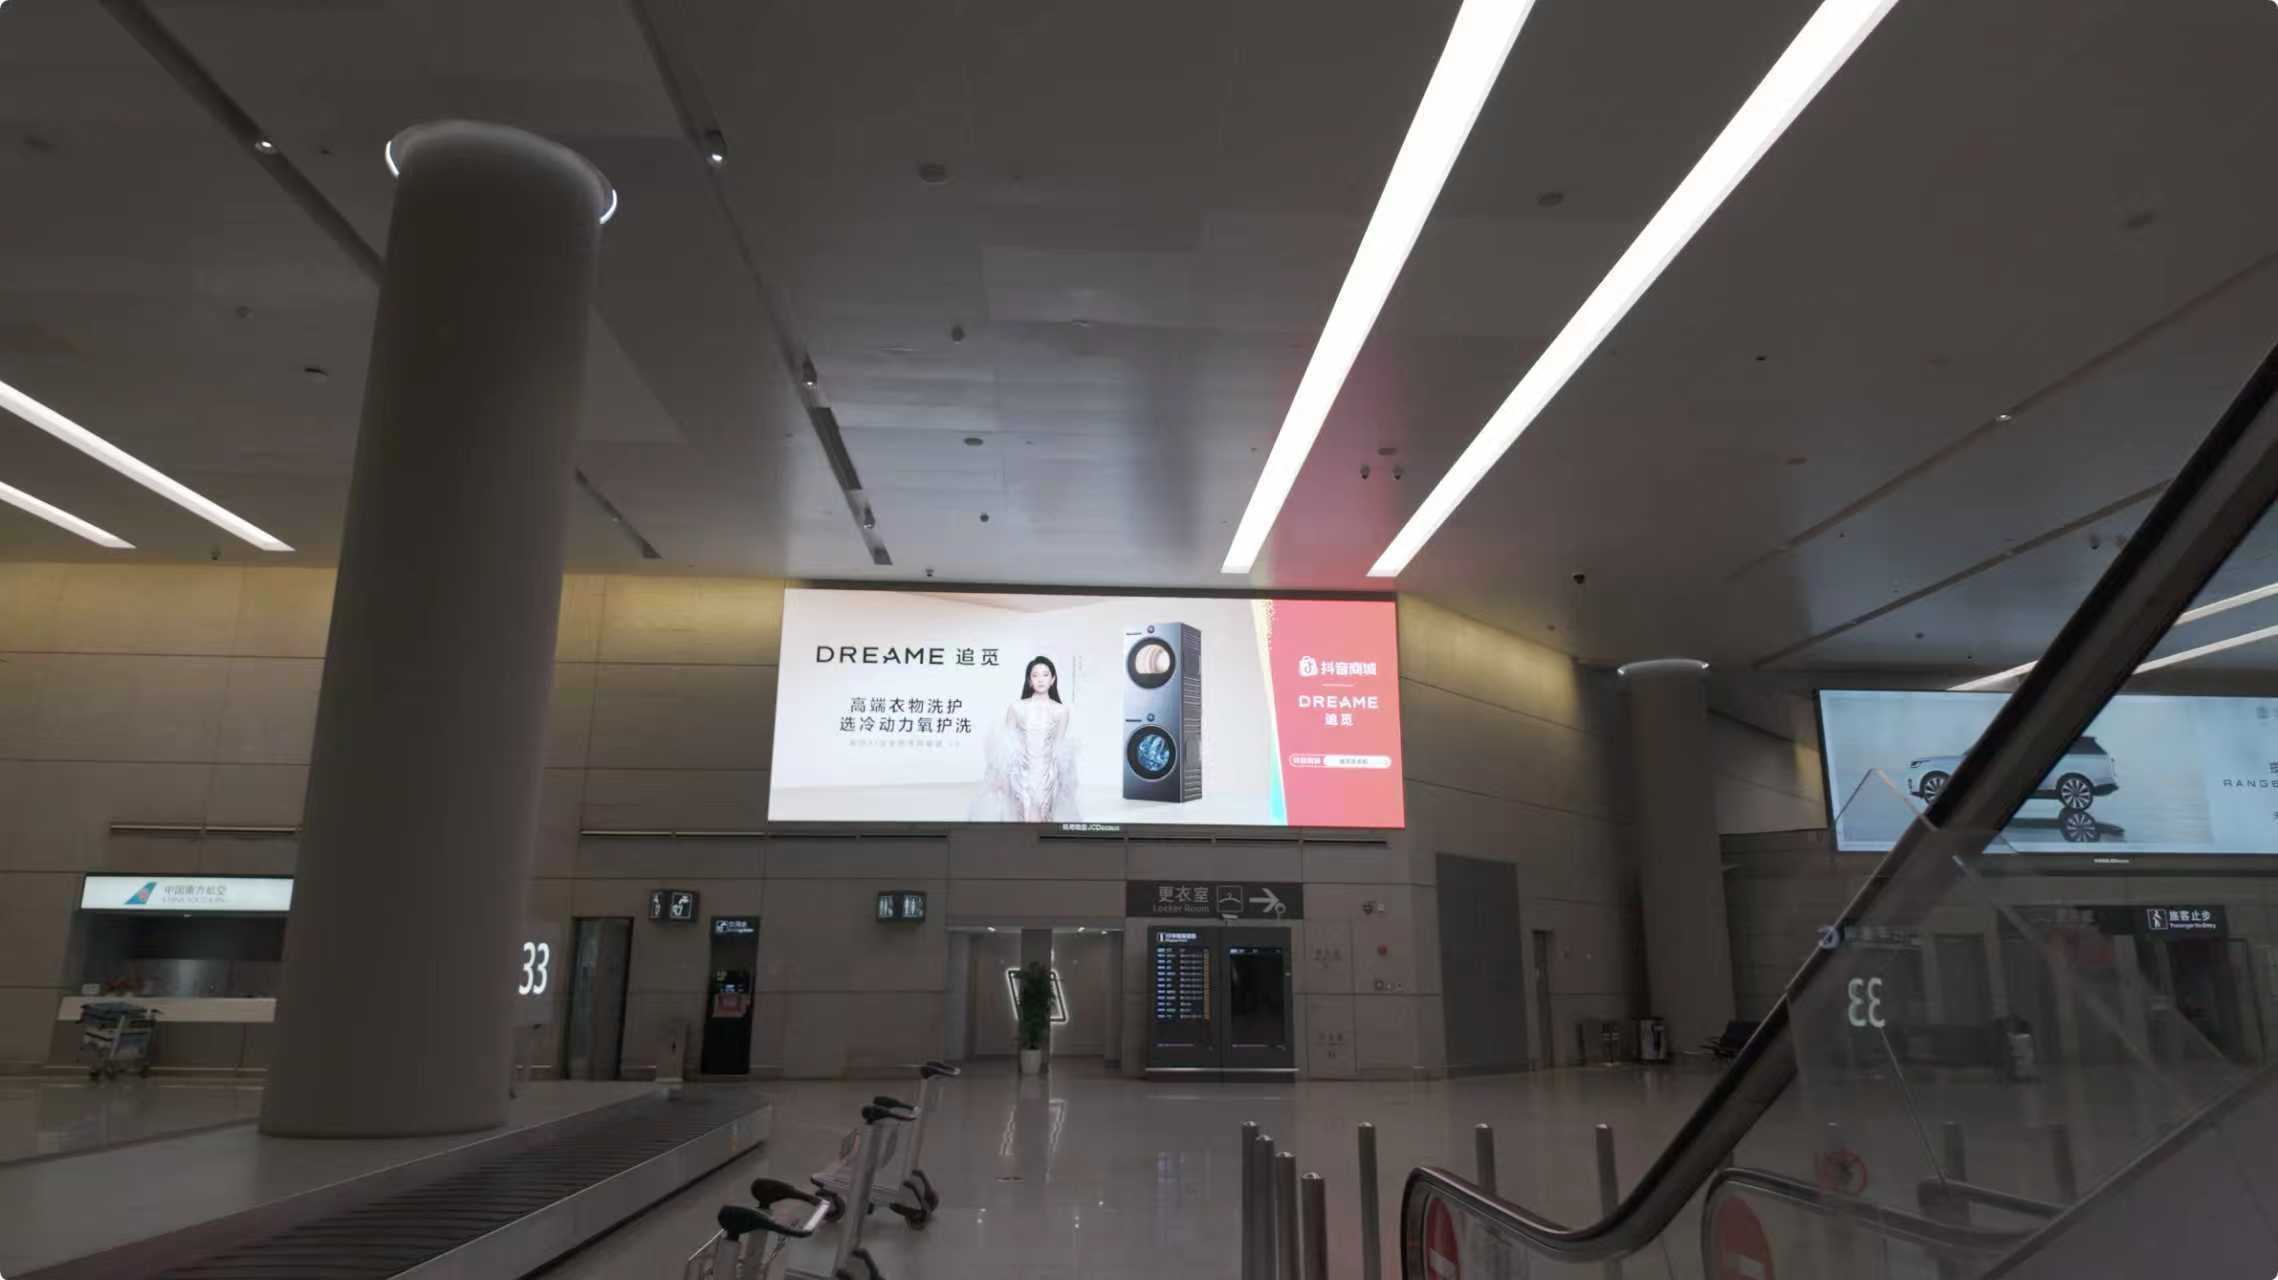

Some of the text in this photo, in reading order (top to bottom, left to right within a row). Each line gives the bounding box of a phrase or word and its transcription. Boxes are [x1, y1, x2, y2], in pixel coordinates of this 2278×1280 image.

[816, 646, 1000, 666] DREAME 追觅
[850, 697, 963, 714] 高端衣物洗护
[1299, 695, 1378, 709] DREAME
[840, 716, 972, 733] 选冷动力氧护洗
[1158, 885, 1209, 903] 更衣室
[1152, 904, 1210, 913] Locker Room
[518, 941, 550, 996] 33
